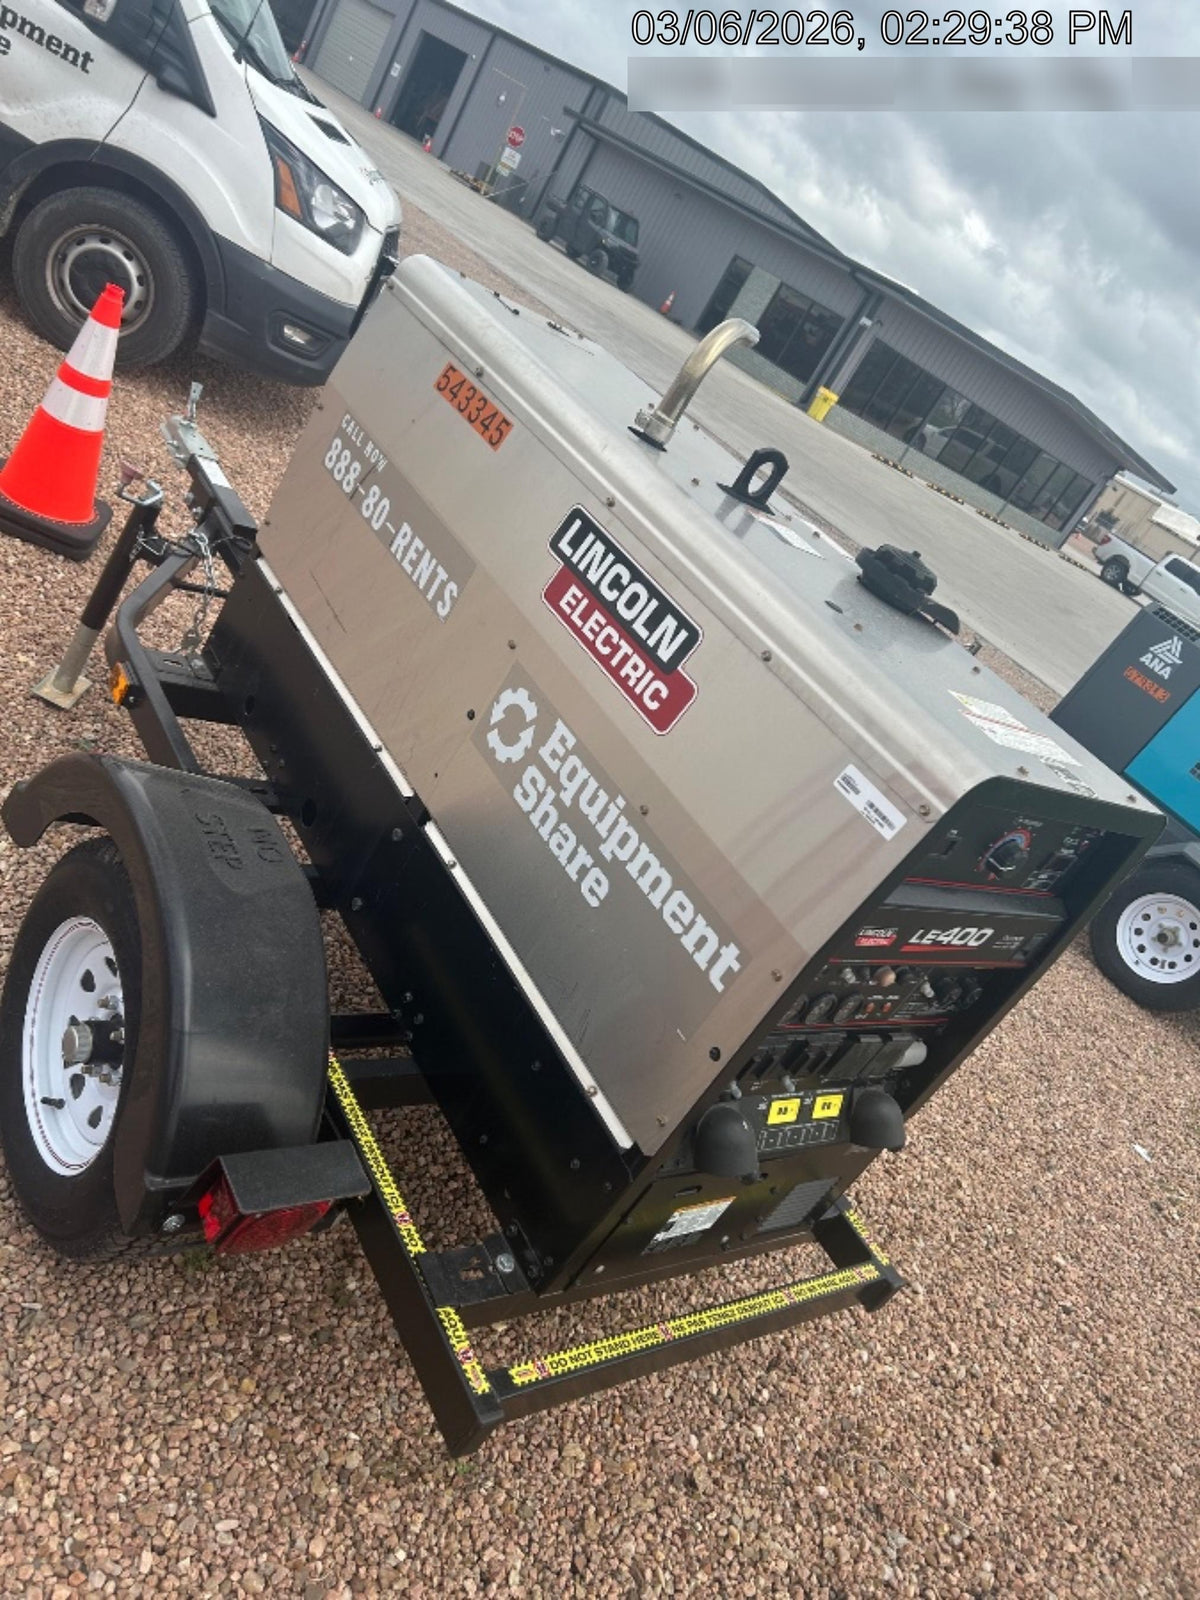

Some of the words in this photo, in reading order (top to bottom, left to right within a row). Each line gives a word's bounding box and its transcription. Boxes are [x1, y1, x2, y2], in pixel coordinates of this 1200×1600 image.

[436, 365, 512, 446] 543345
[341, 413, 365, 447] CALL
[363, 445, 388, 472] NOW
[324, 437, 458, 617] 888-80-RENTS
[557, 518, 690, 664] LINCOLN
[558, 584, 670, 711] ELECTRIC
[1139, 652, 1172, 680] ANA
[194, 812, 243, 870] STEP
[246, 828, 283, 863] NO
[513, 765, 610, 908] Share
[537, 718, 743, 992] Equipment
[908, 927, 994, 947] LE400
[549, 1357, 568, 1370] DO
[569, 1350, 593, 1363] NOT
[594, 1339, 630, 1357] STAND
[633, 1330, 660, 1345] HERE
